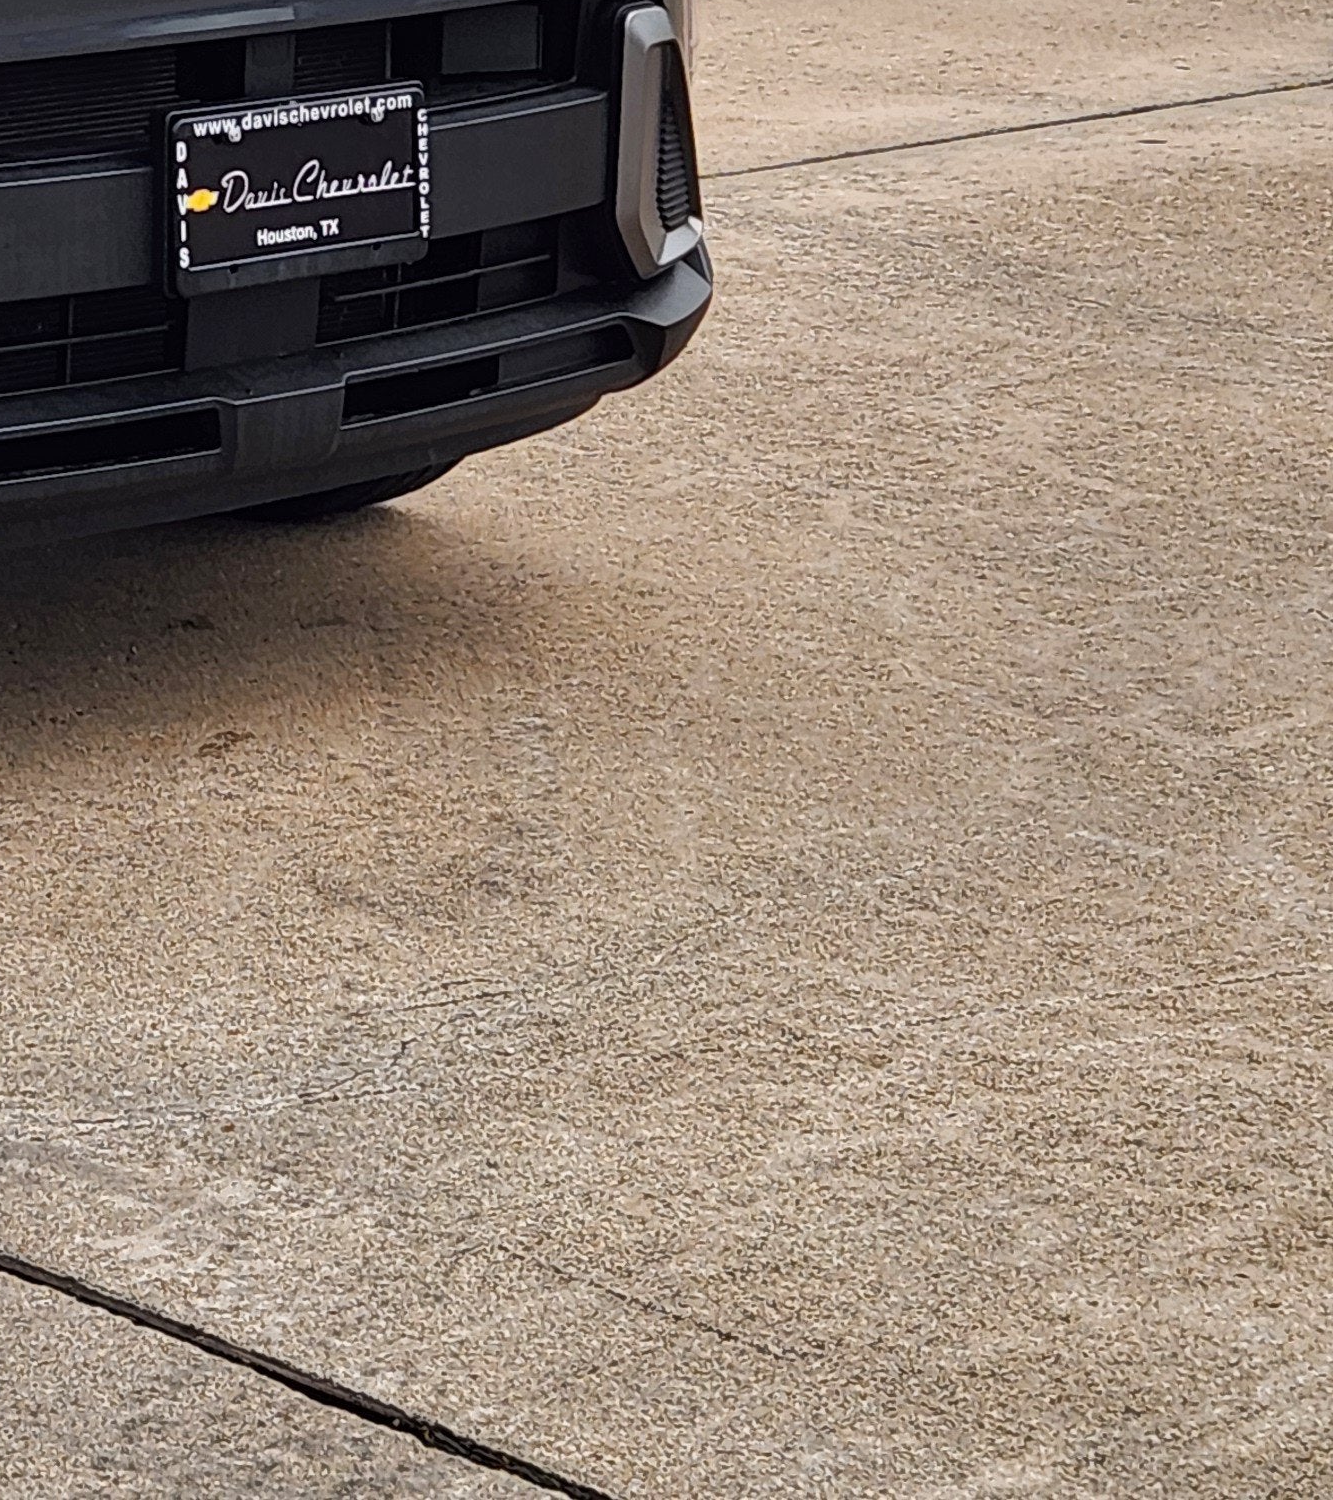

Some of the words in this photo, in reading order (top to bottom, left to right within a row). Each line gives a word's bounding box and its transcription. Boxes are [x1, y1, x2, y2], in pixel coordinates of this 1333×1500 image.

[193, 94, 413, 138] www.davischevrolet.com
[220, 169, 292, 213] Davis
[293, 159, 416, 202] Chevrolet
[417, 108, 431, 238] CHEVROLET
[256, 225, 318, 246] Houston,
[319, 218, 339, 237] TX
